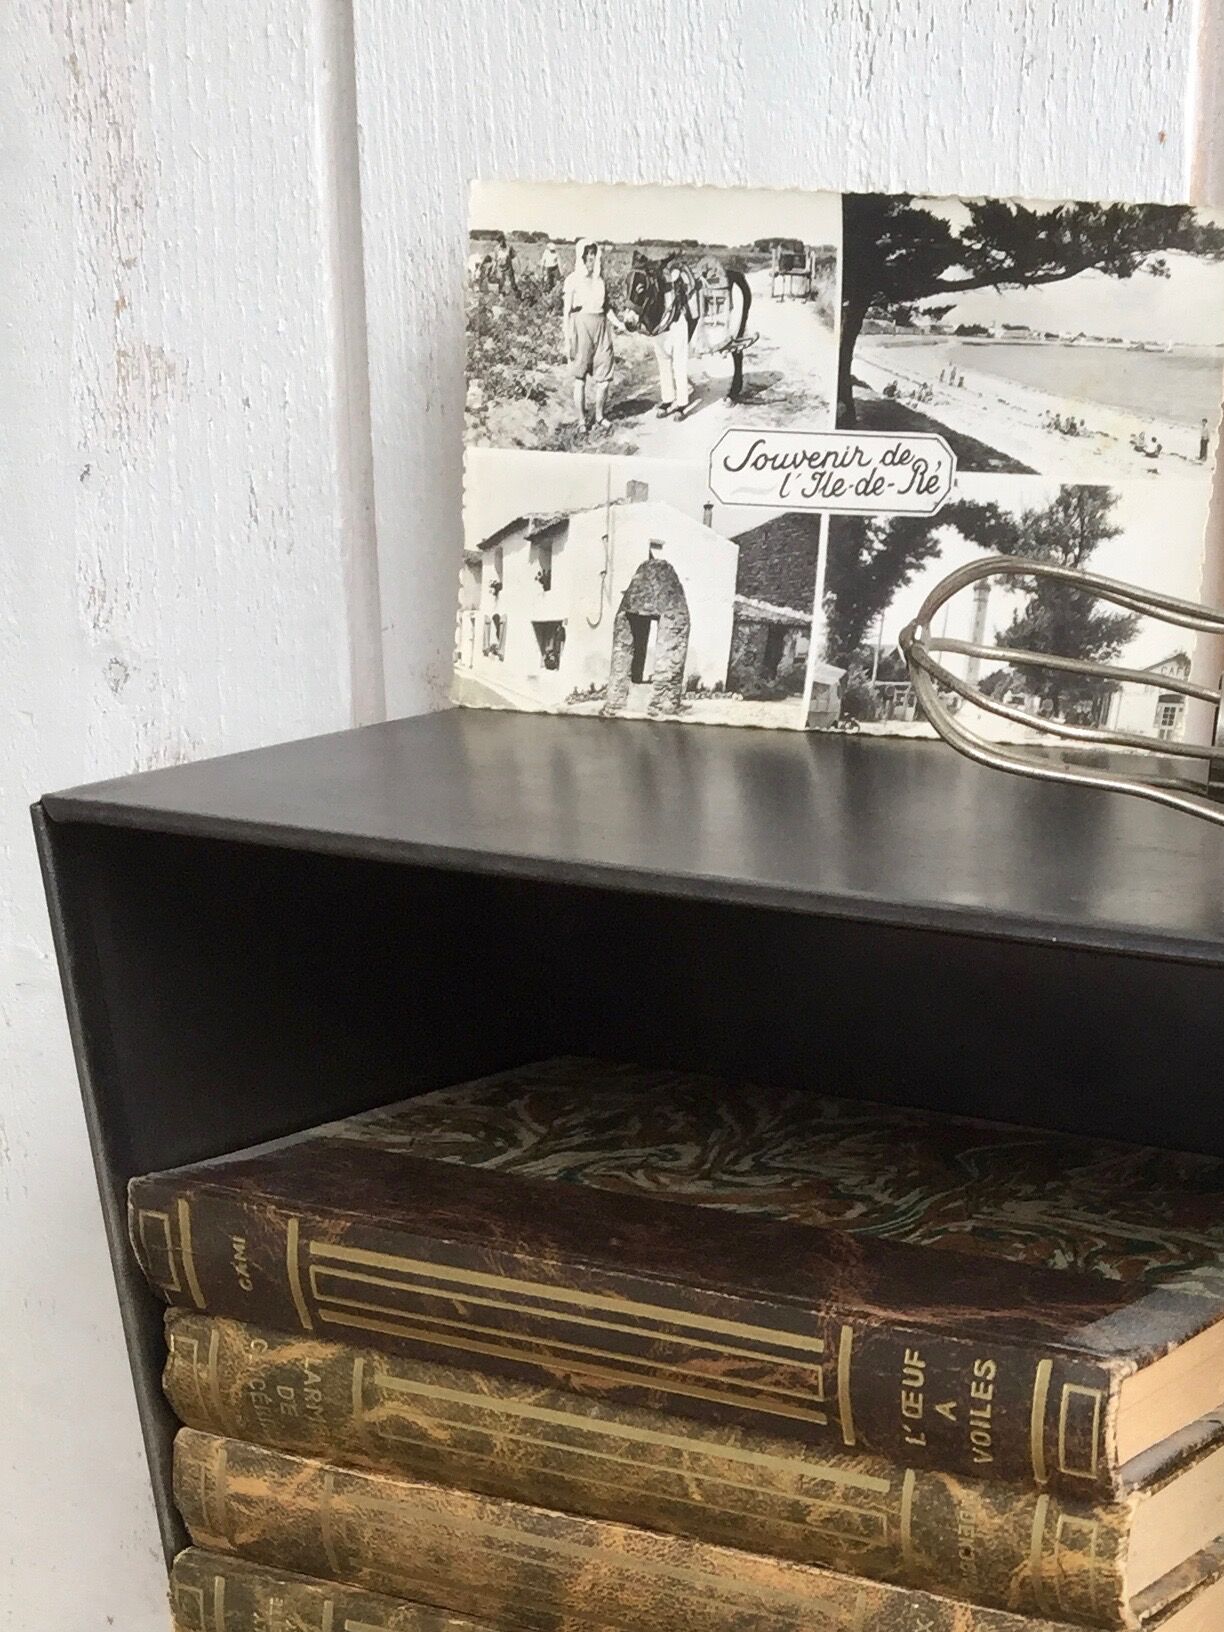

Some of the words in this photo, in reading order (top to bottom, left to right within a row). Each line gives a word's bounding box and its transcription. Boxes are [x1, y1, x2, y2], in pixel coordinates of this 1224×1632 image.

[723, 438, 872, 472] Souvenir
[879, 442, 914, 467] de
[934, 1400, 958, 1422] A
[969, 1358, 997, 1463] VOILES
